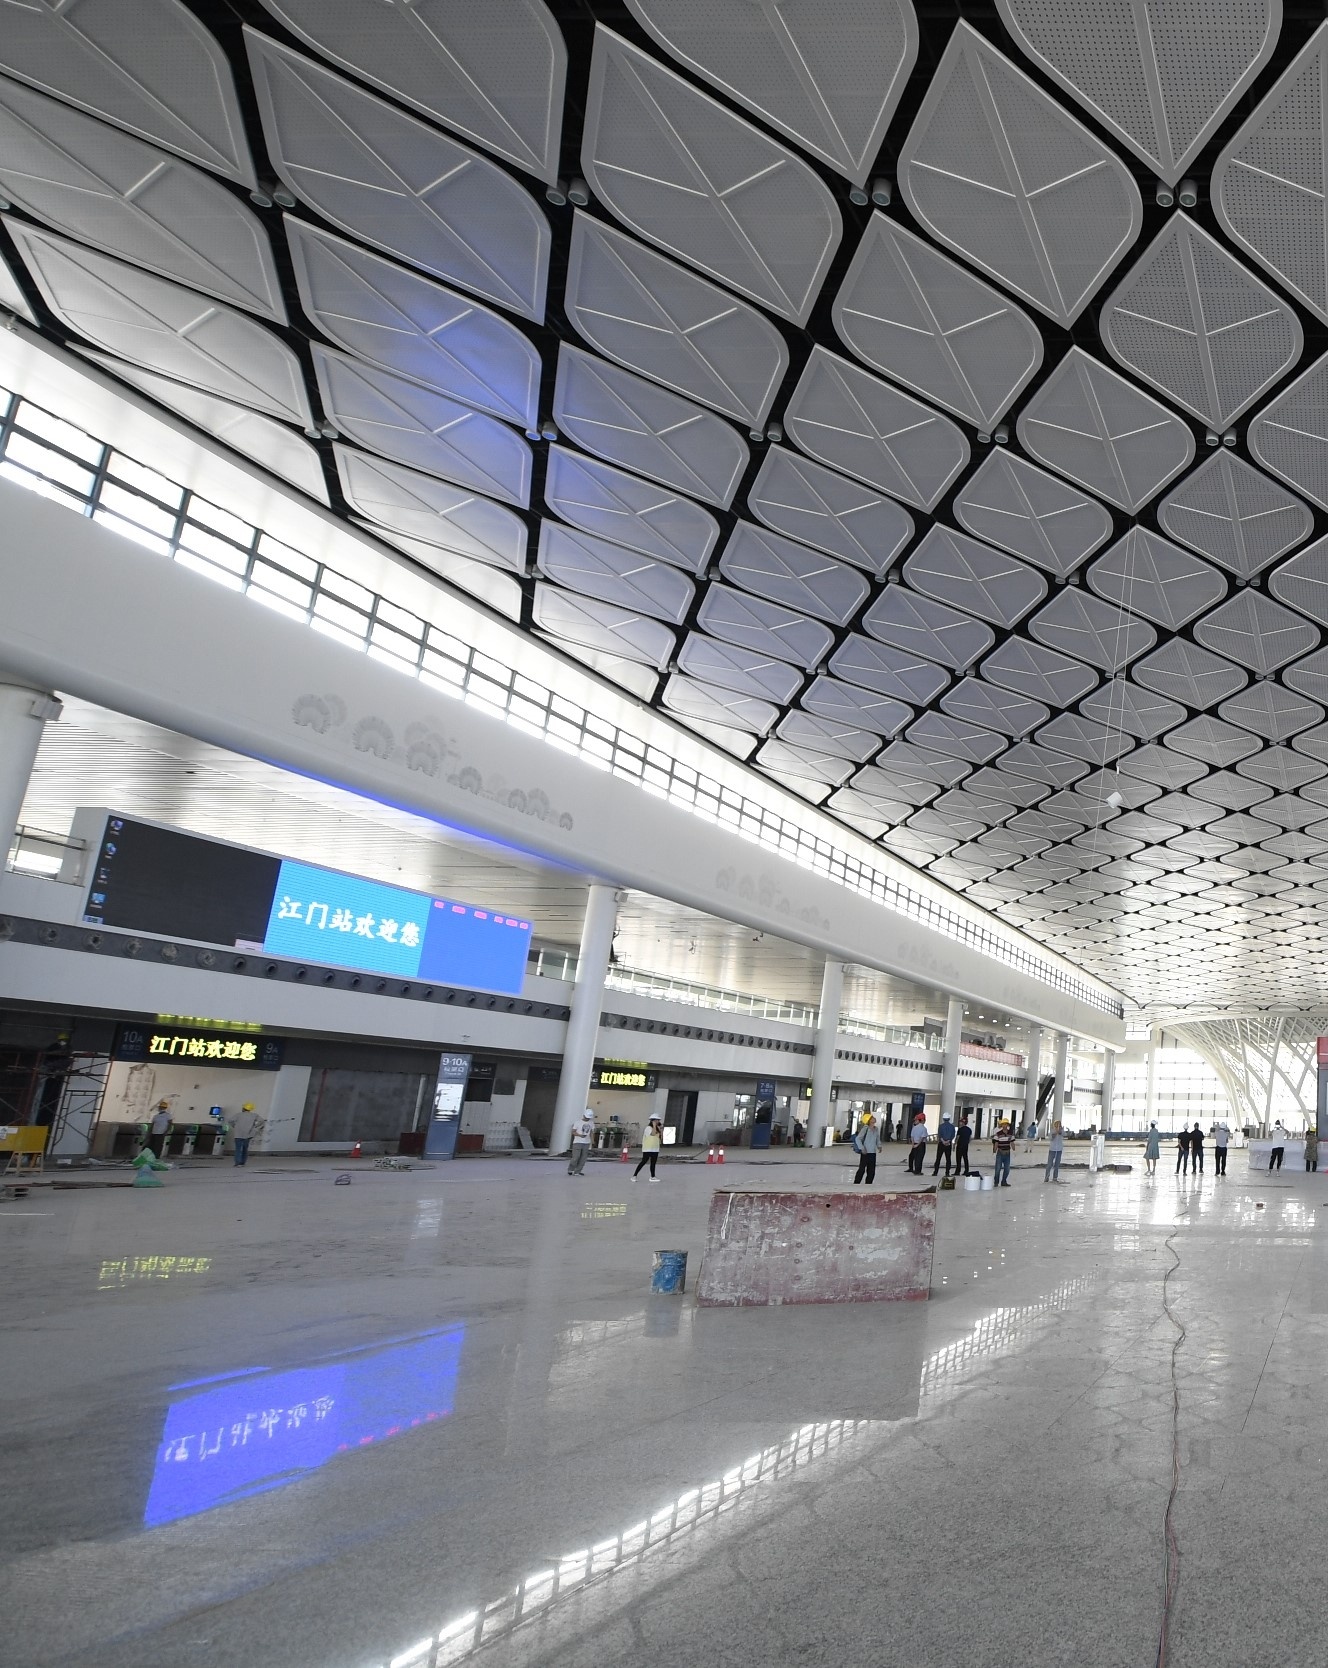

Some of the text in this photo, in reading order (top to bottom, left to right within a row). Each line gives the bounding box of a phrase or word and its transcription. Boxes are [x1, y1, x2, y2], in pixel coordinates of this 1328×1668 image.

[277, 896, 420, 947] 江门站欢迎您
[150, 1035, 257, 1061] 江门站欢迎您
